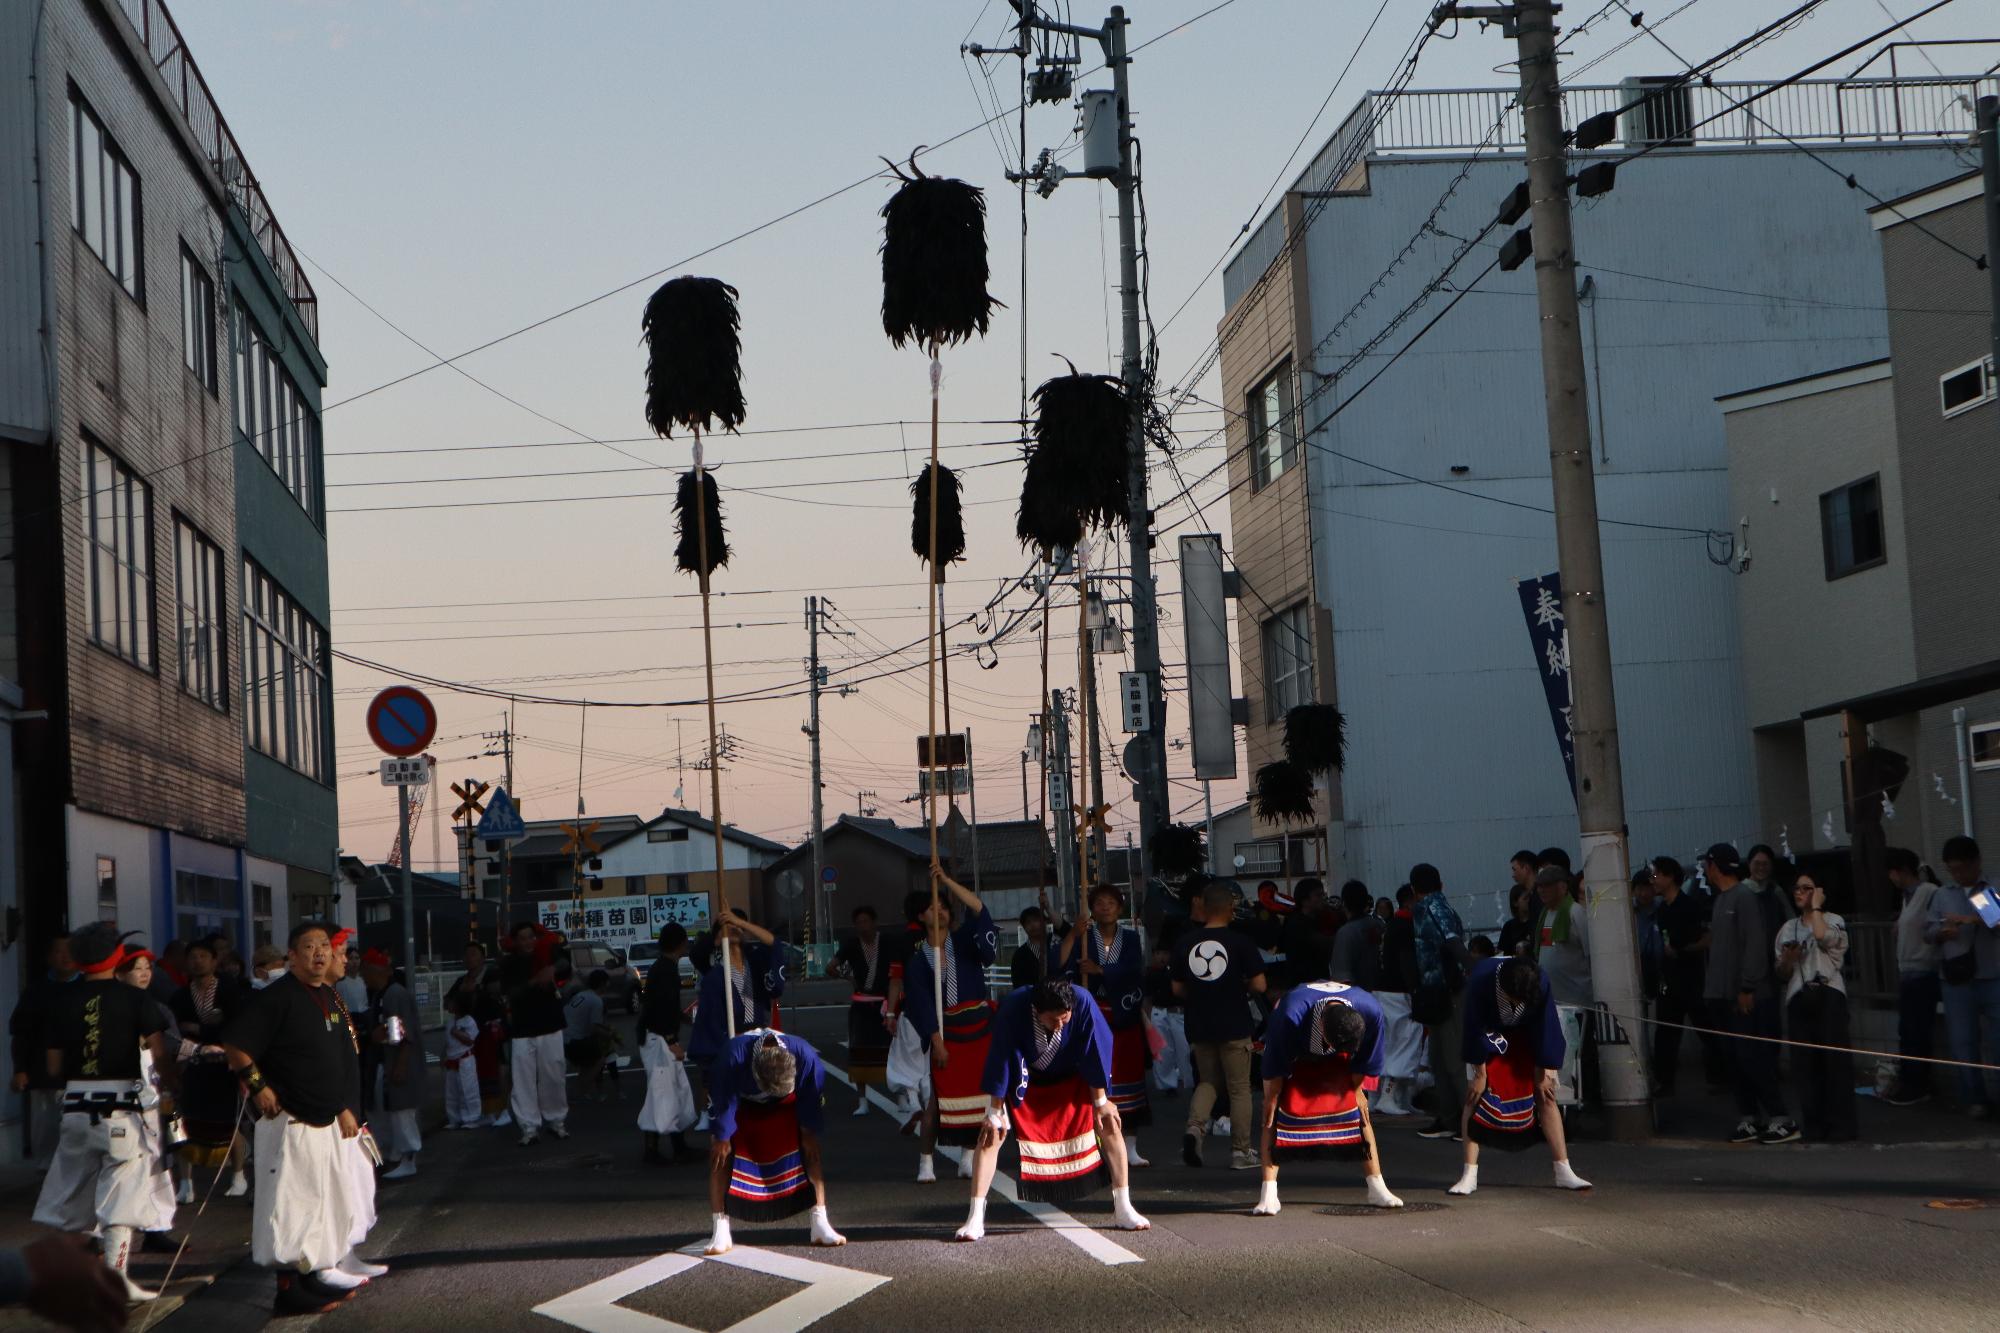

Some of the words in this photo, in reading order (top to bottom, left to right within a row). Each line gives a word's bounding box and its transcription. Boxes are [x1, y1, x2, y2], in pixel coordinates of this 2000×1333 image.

[1129, 677, 1142, 727] 宮脇書店
[653, 897, 699, 911] 見守って
